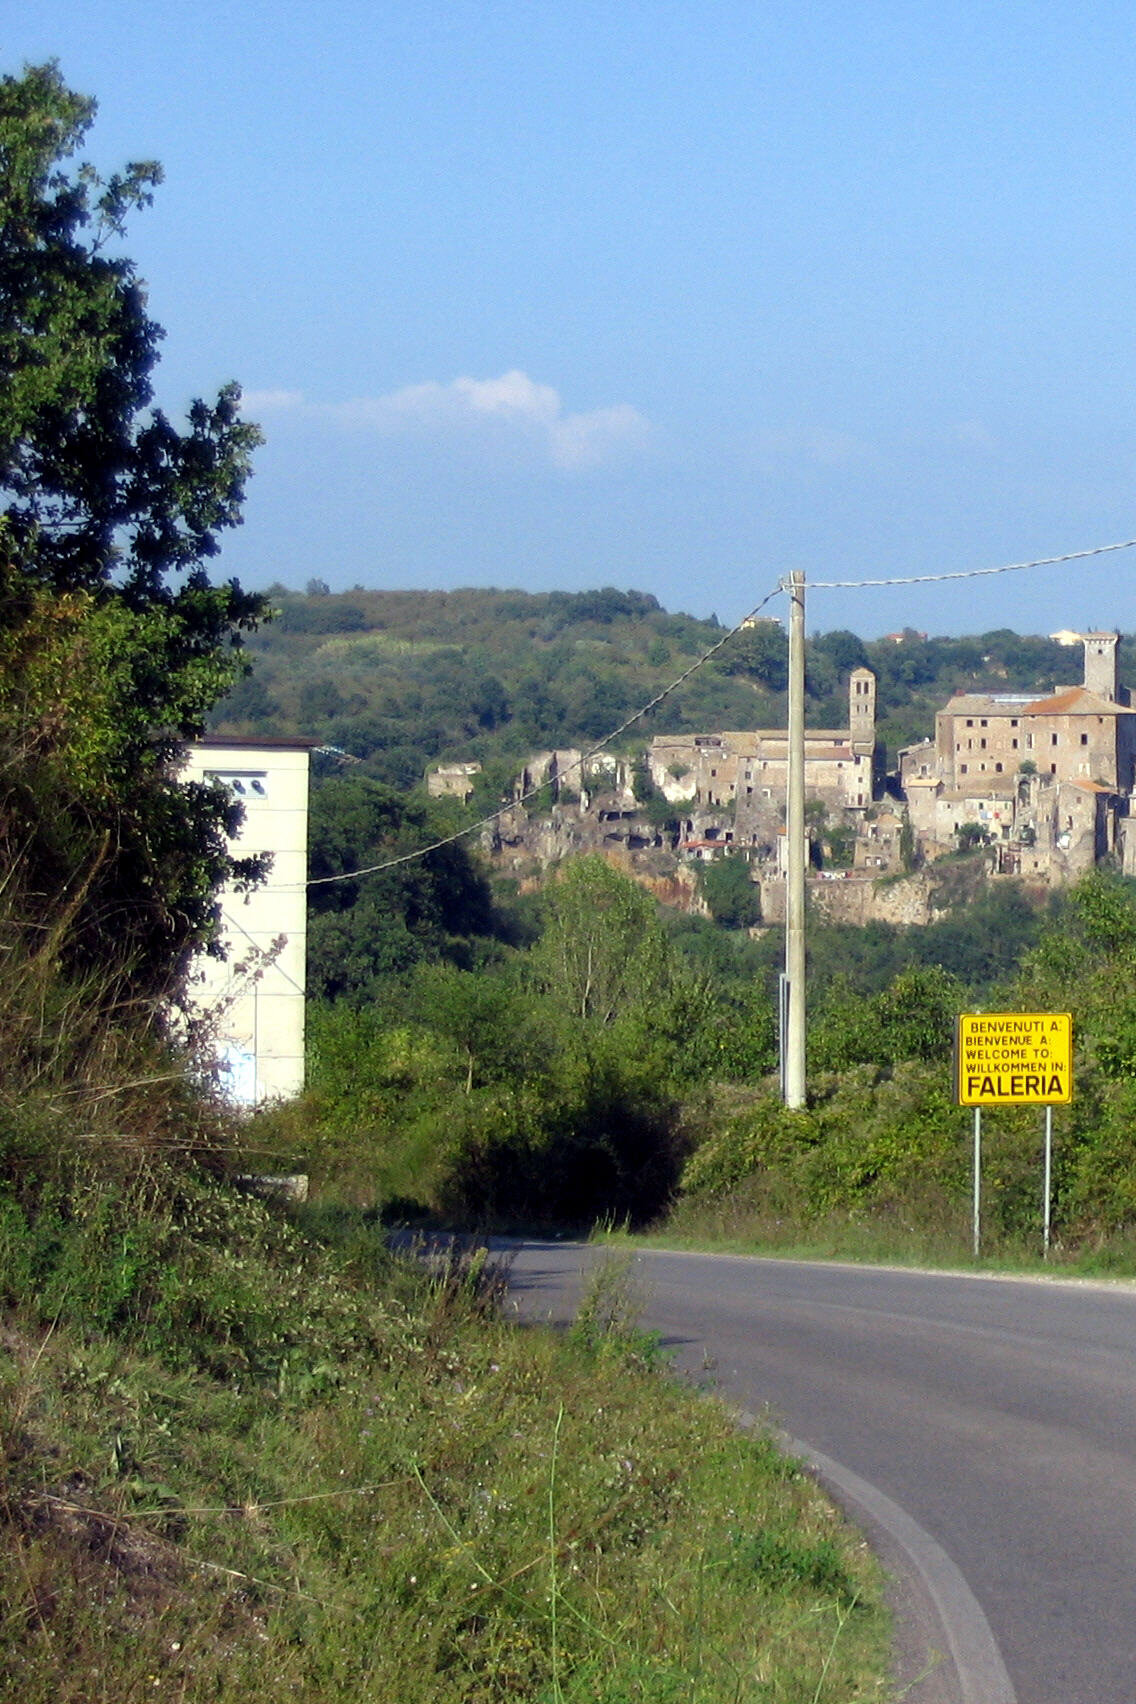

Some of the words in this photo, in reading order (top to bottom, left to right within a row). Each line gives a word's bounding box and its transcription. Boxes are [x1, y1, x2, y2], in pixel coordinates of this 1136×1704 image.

[971, 1022, 1044, 1033] BENVENUTI
[965, 1036, 1032, 1046] BIENVENUE
[966, 1049, 1027, 1060] WELCOME
[966, 1062, 1046, 1073] WILLKOMMEN
[967, 1075, 1063, 1097] FALERIA
